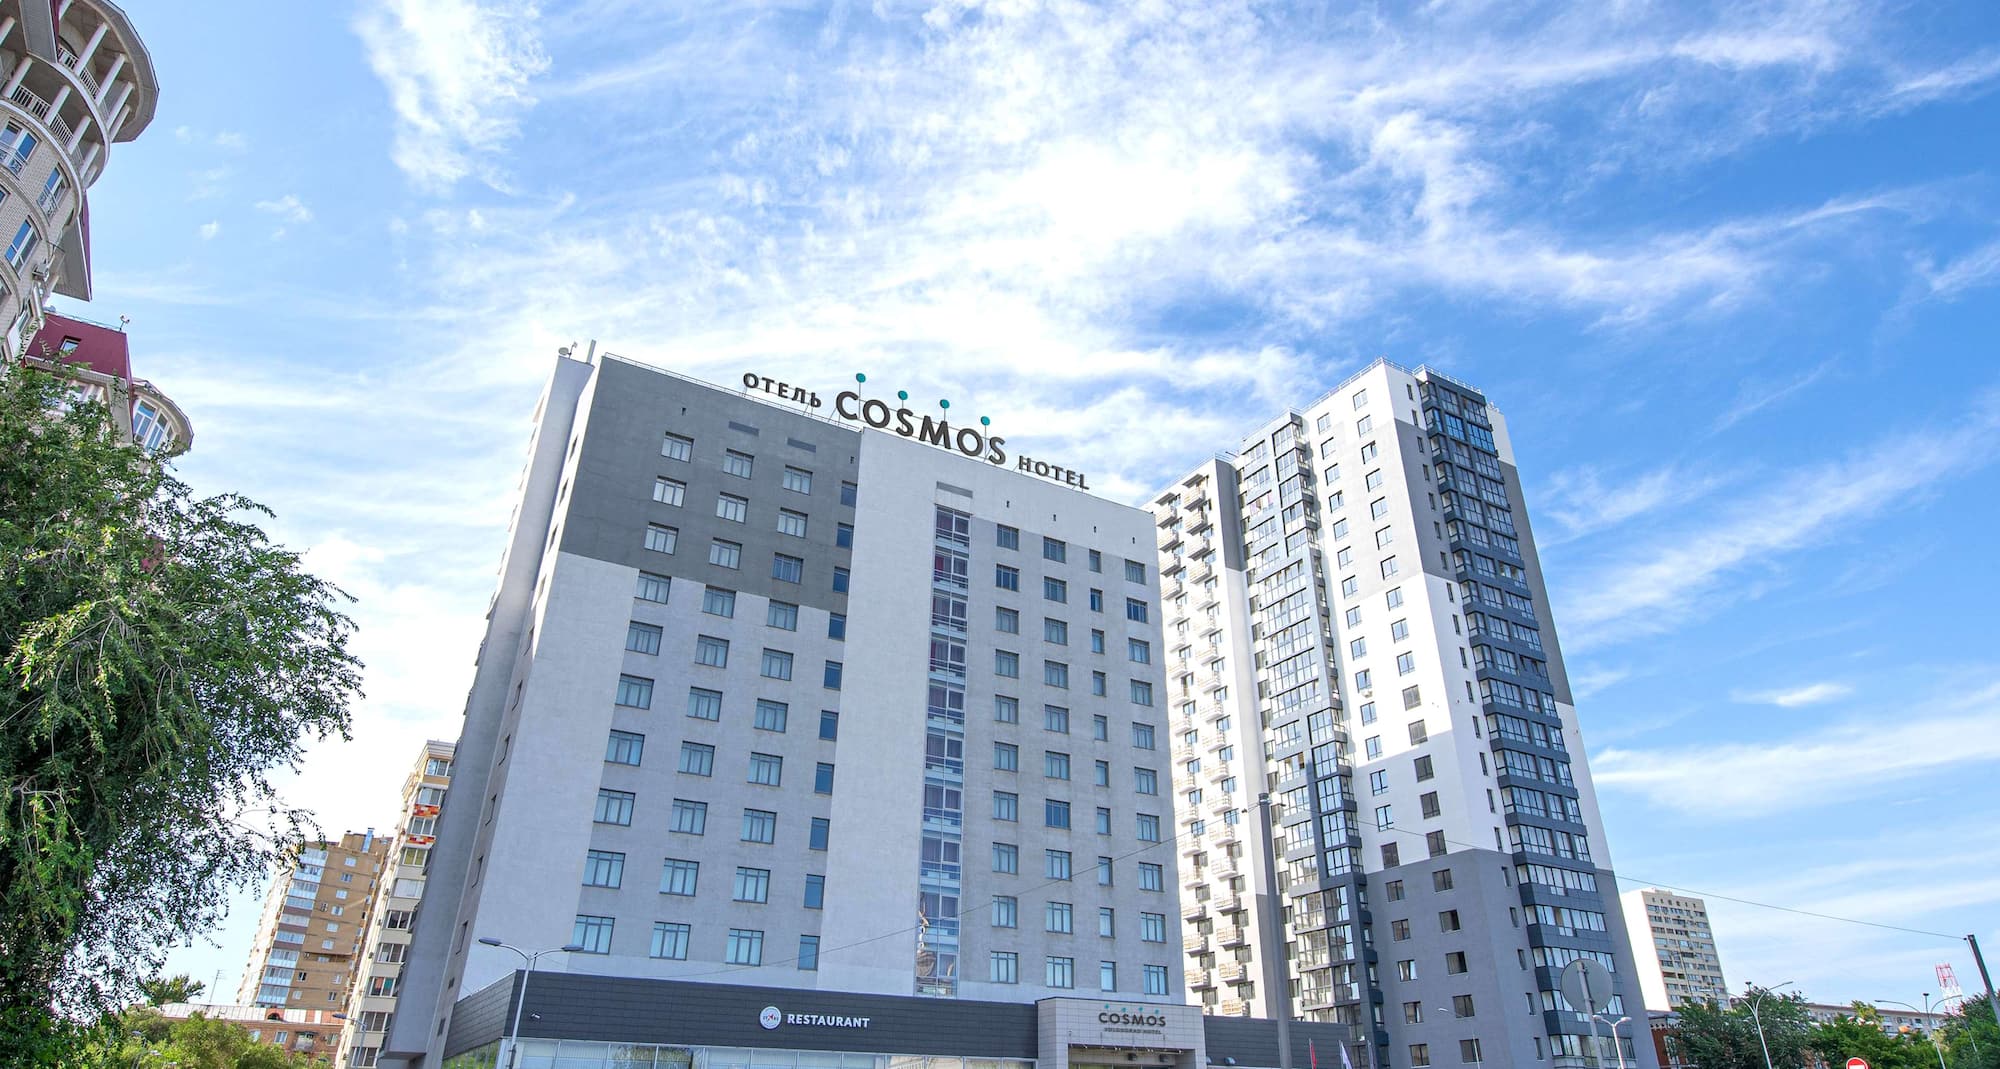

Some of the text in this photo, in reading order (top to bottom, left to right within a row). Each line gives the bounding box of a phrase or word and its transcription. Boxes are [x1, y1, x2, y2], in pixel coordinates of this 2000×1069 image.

[743, 372, 1090, 490] ОТЕЛЬ COSMOS HOTEL
[787, 1013, 870, 1028] RESTAURANT
[1099, 1012, 1166, 1027] COSMOS
